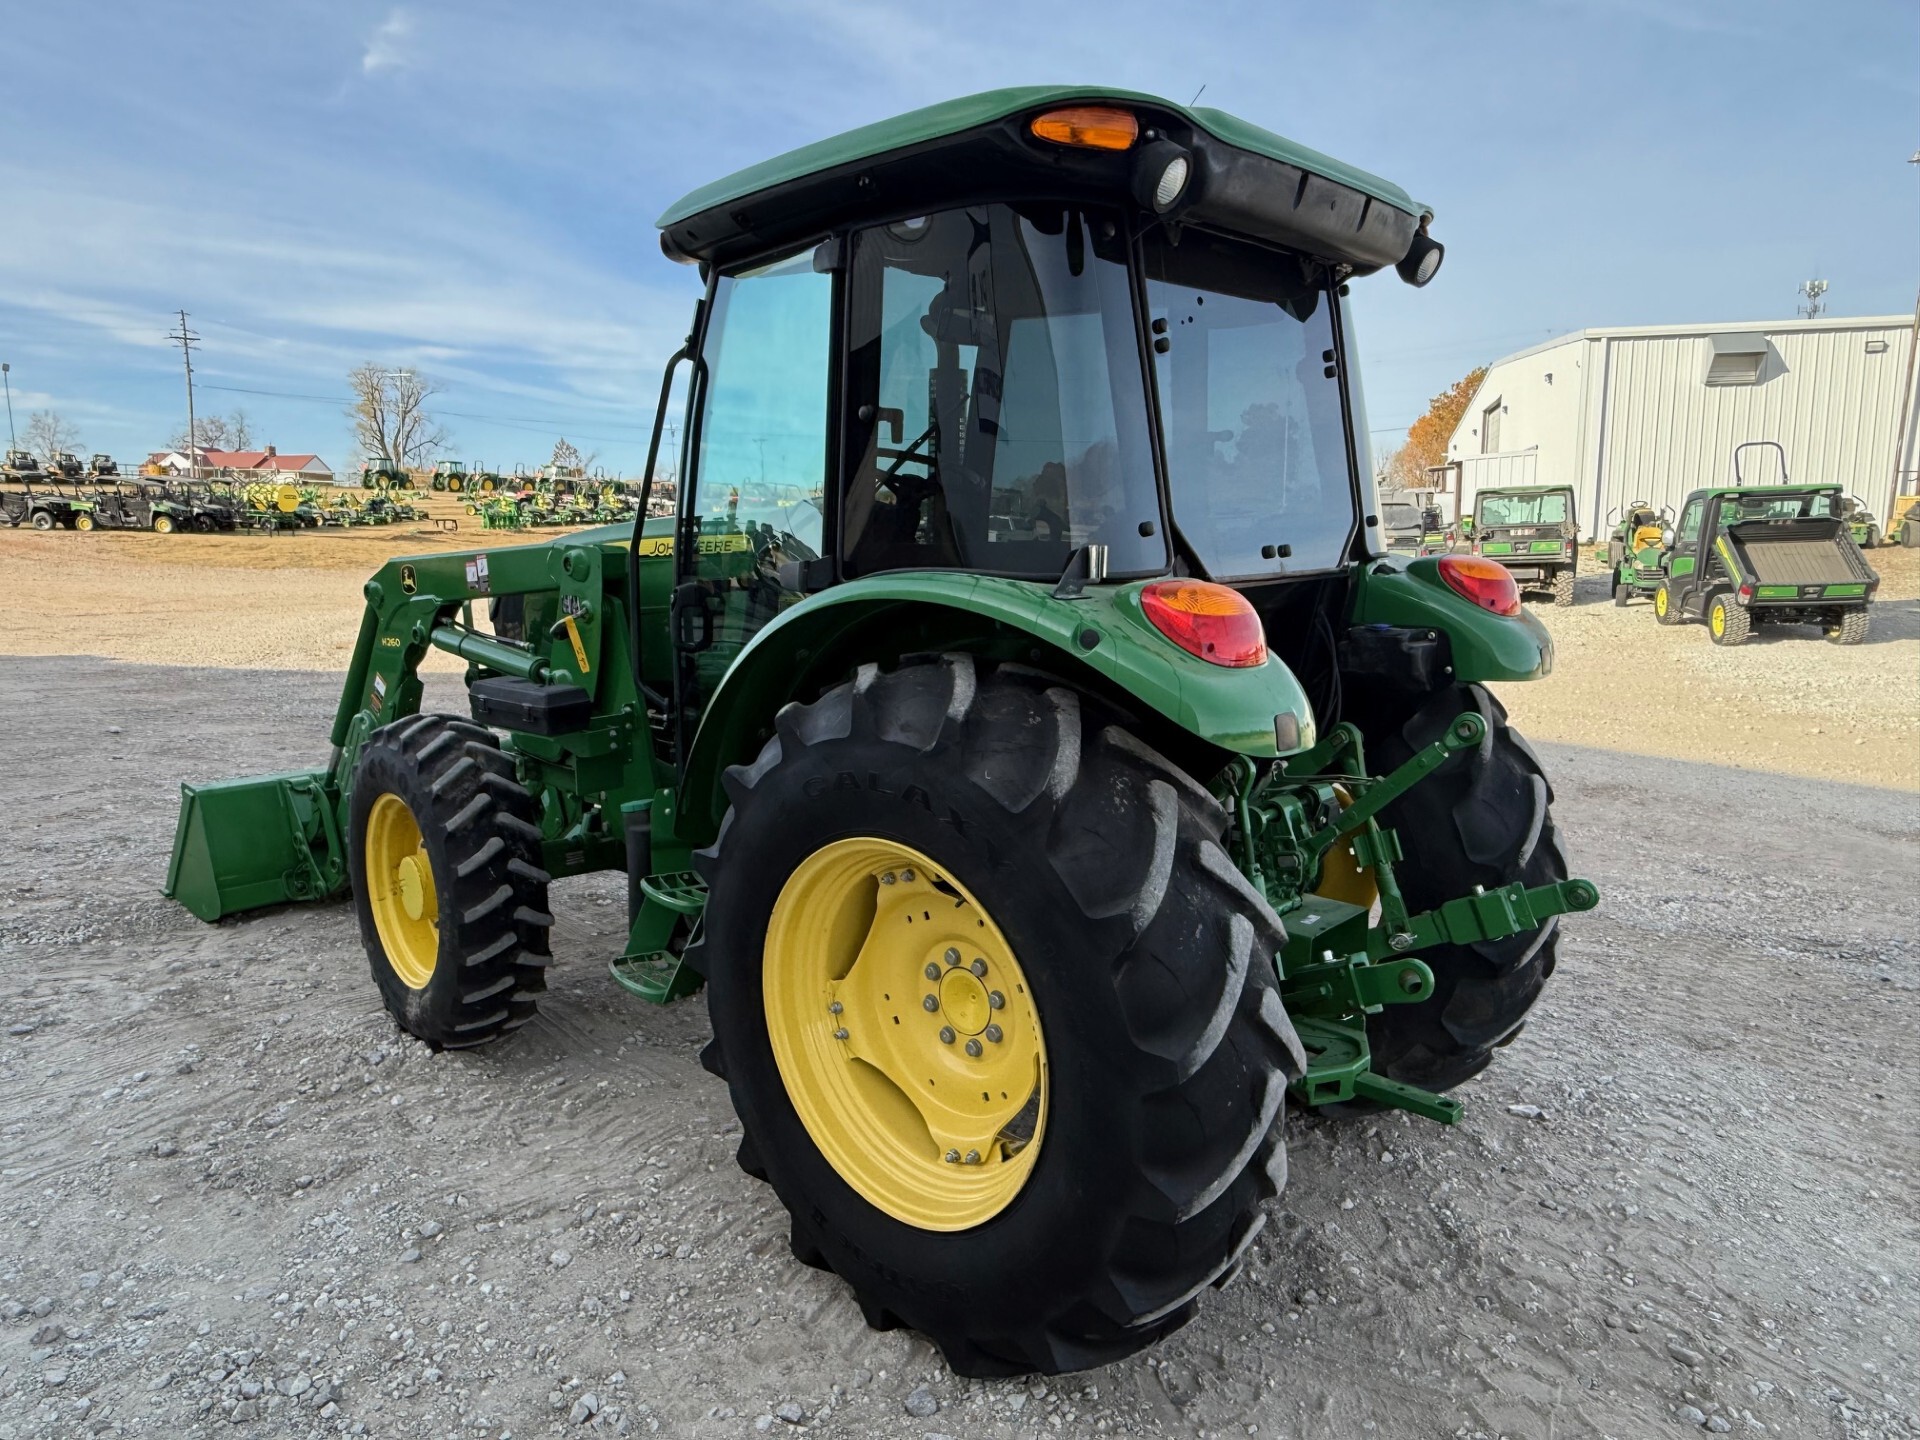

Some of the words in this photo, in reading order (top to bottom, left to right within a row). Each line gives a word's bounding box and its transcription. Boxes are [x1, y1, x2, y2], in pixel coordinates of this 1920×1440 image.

[649, 541, 674, 555] JOH
[698, 540, 732, 552] EERE
[381, 637, 401, 648] H260
